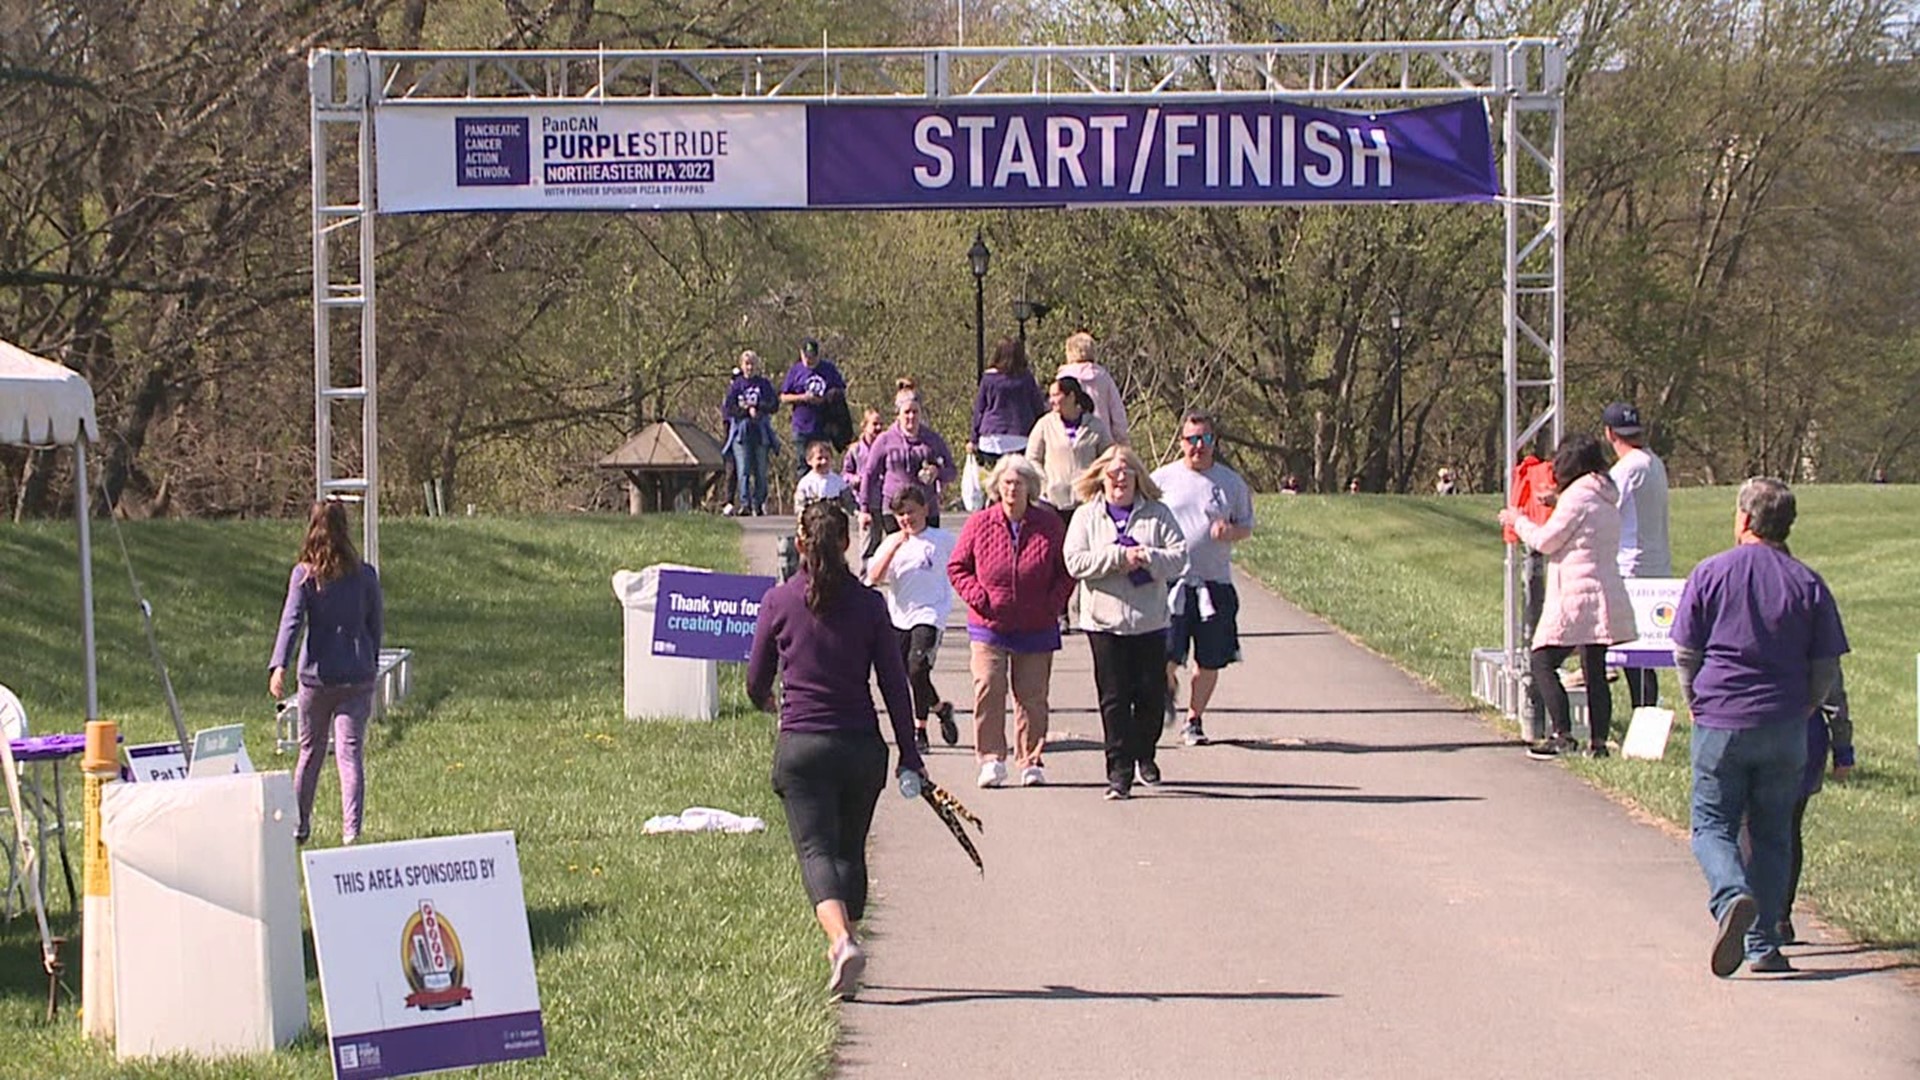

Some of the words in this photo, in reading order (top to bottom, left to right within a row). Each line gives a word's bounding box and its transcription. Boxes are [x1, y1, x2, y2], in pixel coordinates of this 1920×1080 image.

[464, 122, 521, 138] PANCREATIC
[542, 117, 598, 132] PanCAN
[464, 137, 502, 152] CANCER
[542, 130, 729, 160] PURPLESTRIDE
[912, 109, 1394, 195] START/FINISH
[464, 151, 499, 165] ACTION
[465, 164, 511, 179] NETWORK
[546, 164, 653, 182] NORTHEASTERN
[657, 163, 676, 180] PA
[678, 162, 711, 180] 2022
[544, 187, 565, 197] WITH
[567, 186, 600, 197] PREMIER
[602, 185, 637, 196] SPONSOR
[669, 594, 711, 613] Thank
[713, 599, 737, 618] you
[740, 598, 761, 616] for
[668, 615, 722, 637] creating
[150, 768, 175, 781] Pat
[333, 872, 366, 895] THIS
[368, 867, 403, 892] AREA
[405, 860, 478, 887] SPONSORED
[480, 858, 496, 879] BY
